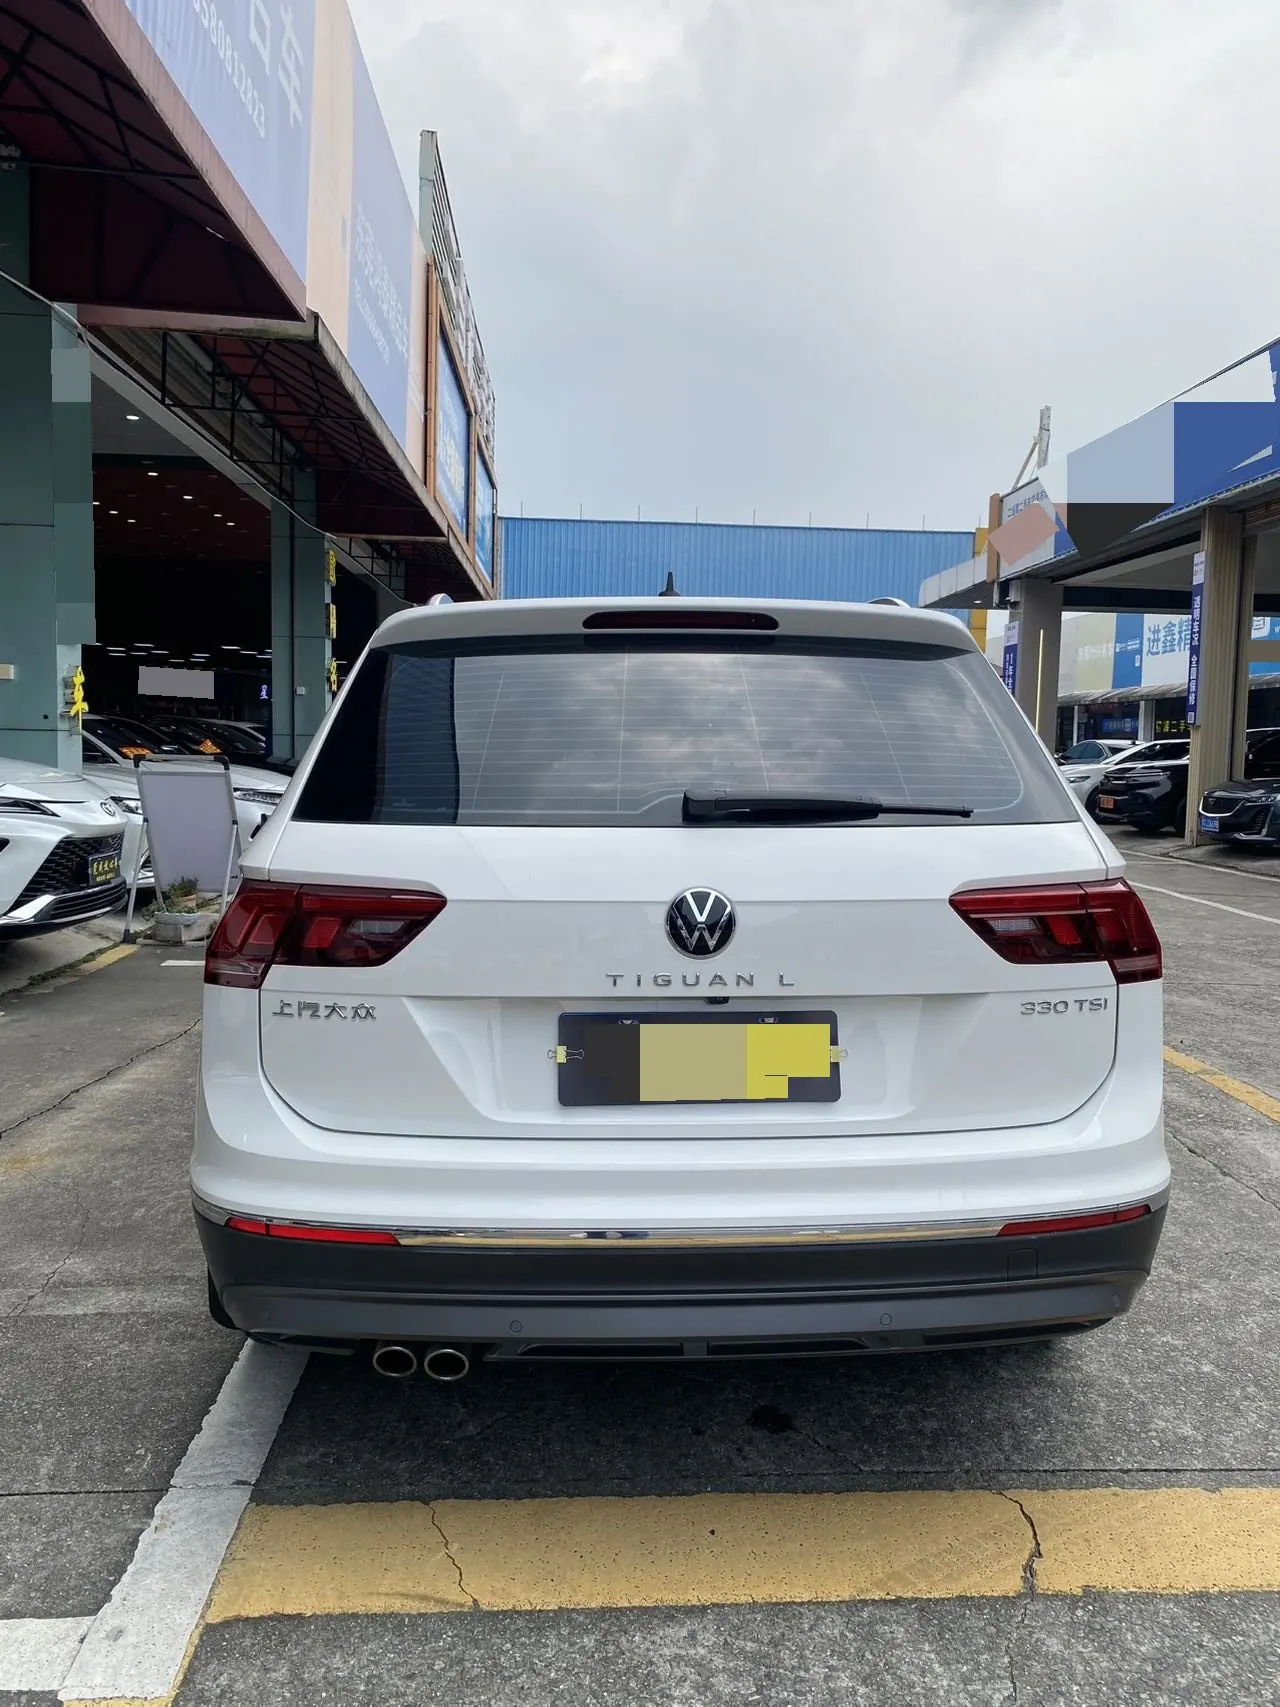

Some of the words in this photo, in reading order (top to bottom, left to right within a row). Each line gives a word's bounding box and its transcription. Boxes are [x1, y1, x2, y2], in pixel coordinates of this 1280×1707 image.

[606, 972, 754, 987] TIGUAN
[779, 972, 795, 987] L
[272, 999, 376, 1020] 上汽大众
[1020, 1000, 1069, 1016] 330
[1074, 998, 1108, 1012] TSI
